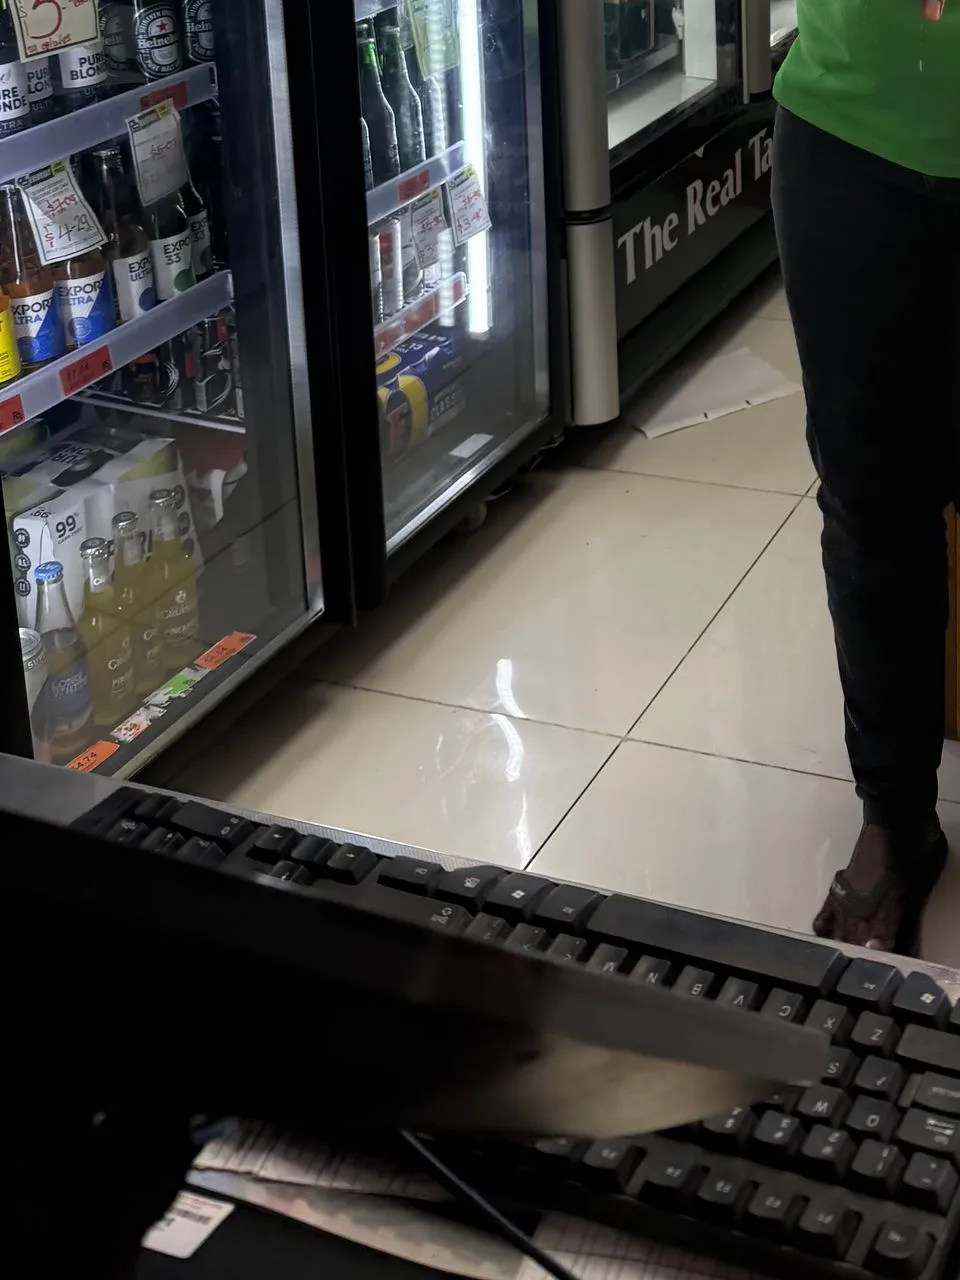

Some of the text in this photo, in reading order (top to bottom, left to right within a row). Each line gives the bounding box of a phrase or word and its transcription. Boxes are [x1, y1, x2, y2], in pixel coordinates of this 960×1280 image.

[70, 64, 104, 80] BLON
[617, 212, 679, 286] The
[686, 148, 743, 234] Real
[163, 236, 190, 255] EXPO
[129, 257, 150, 273] EXP
[11, 297, 51, 317] XPOR
